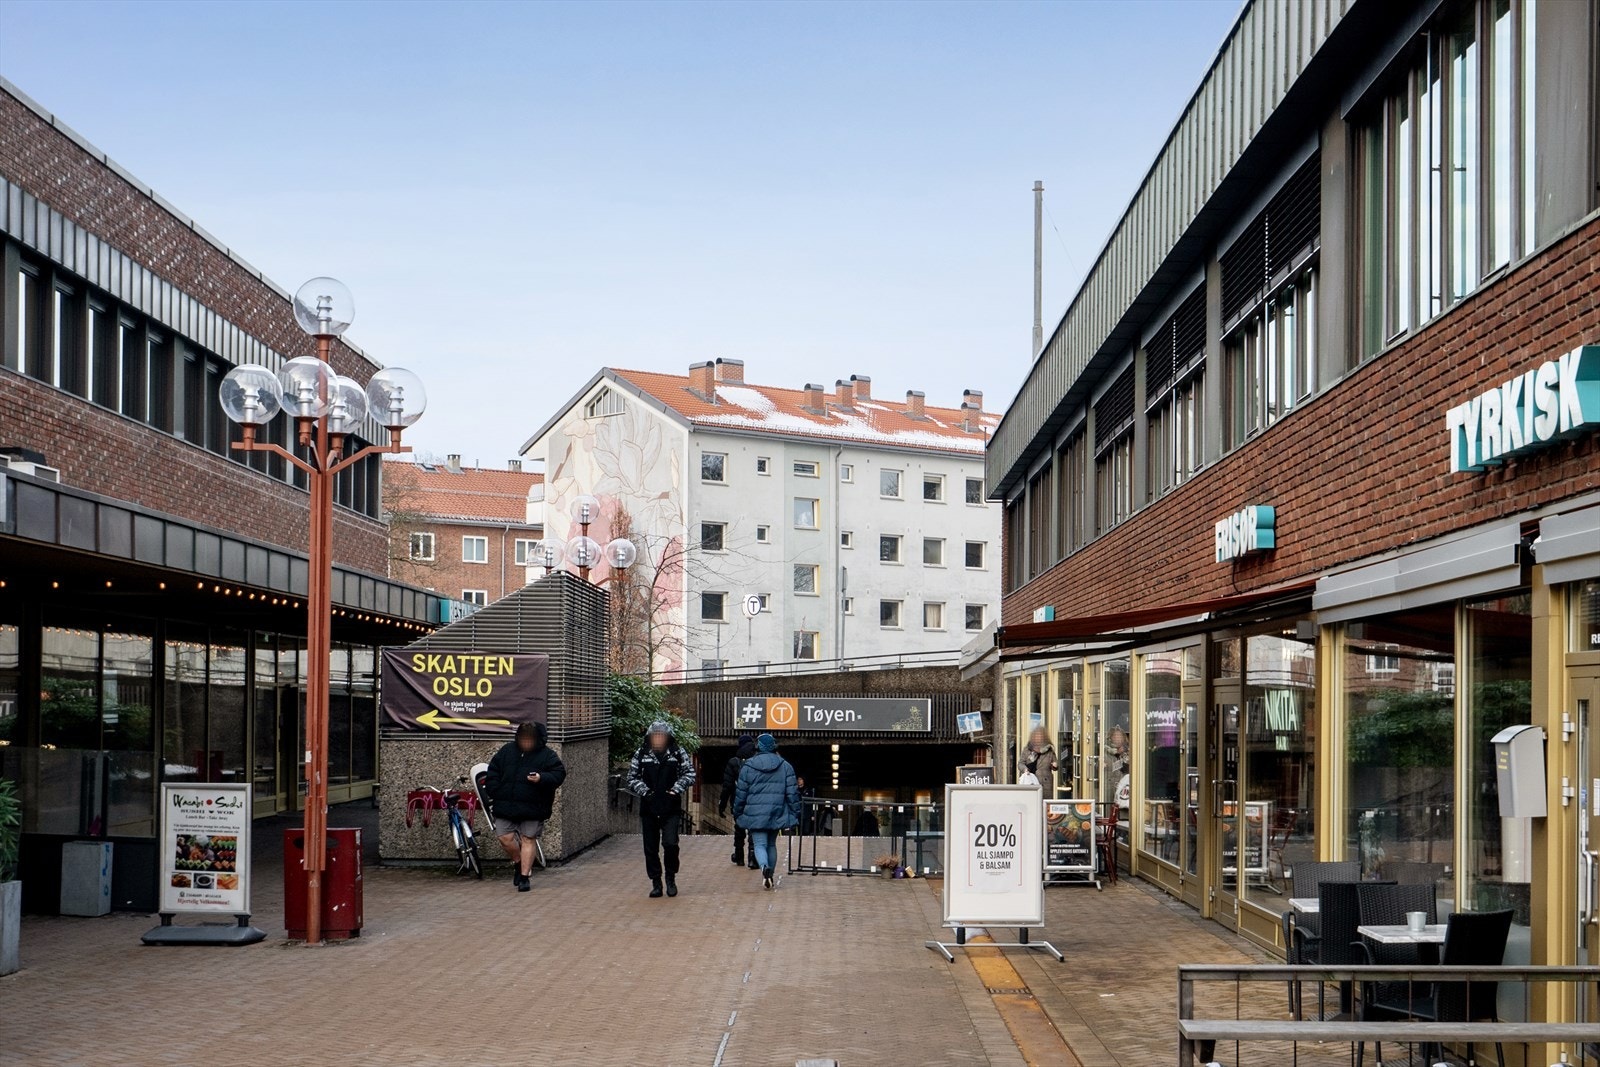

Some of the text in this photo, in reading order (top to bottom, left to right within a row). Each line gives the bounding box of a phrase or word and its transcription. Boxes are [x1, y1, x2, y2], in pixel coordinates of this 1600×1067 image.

[1446, 345, 1584, 474] TYRKISK
[1215, 505, 1258, 563] FRISØR
[412, 653, 514, 676] SKATTEN
[433, 676, 493, 697] OSLO
[964, 776, 990, 785] Salat!
[974, 824, 1016, 847] 20%
[976, 851, 1014, 860] ALL SJAMPO
[979, 861, 1011, 870] & BALSAM
